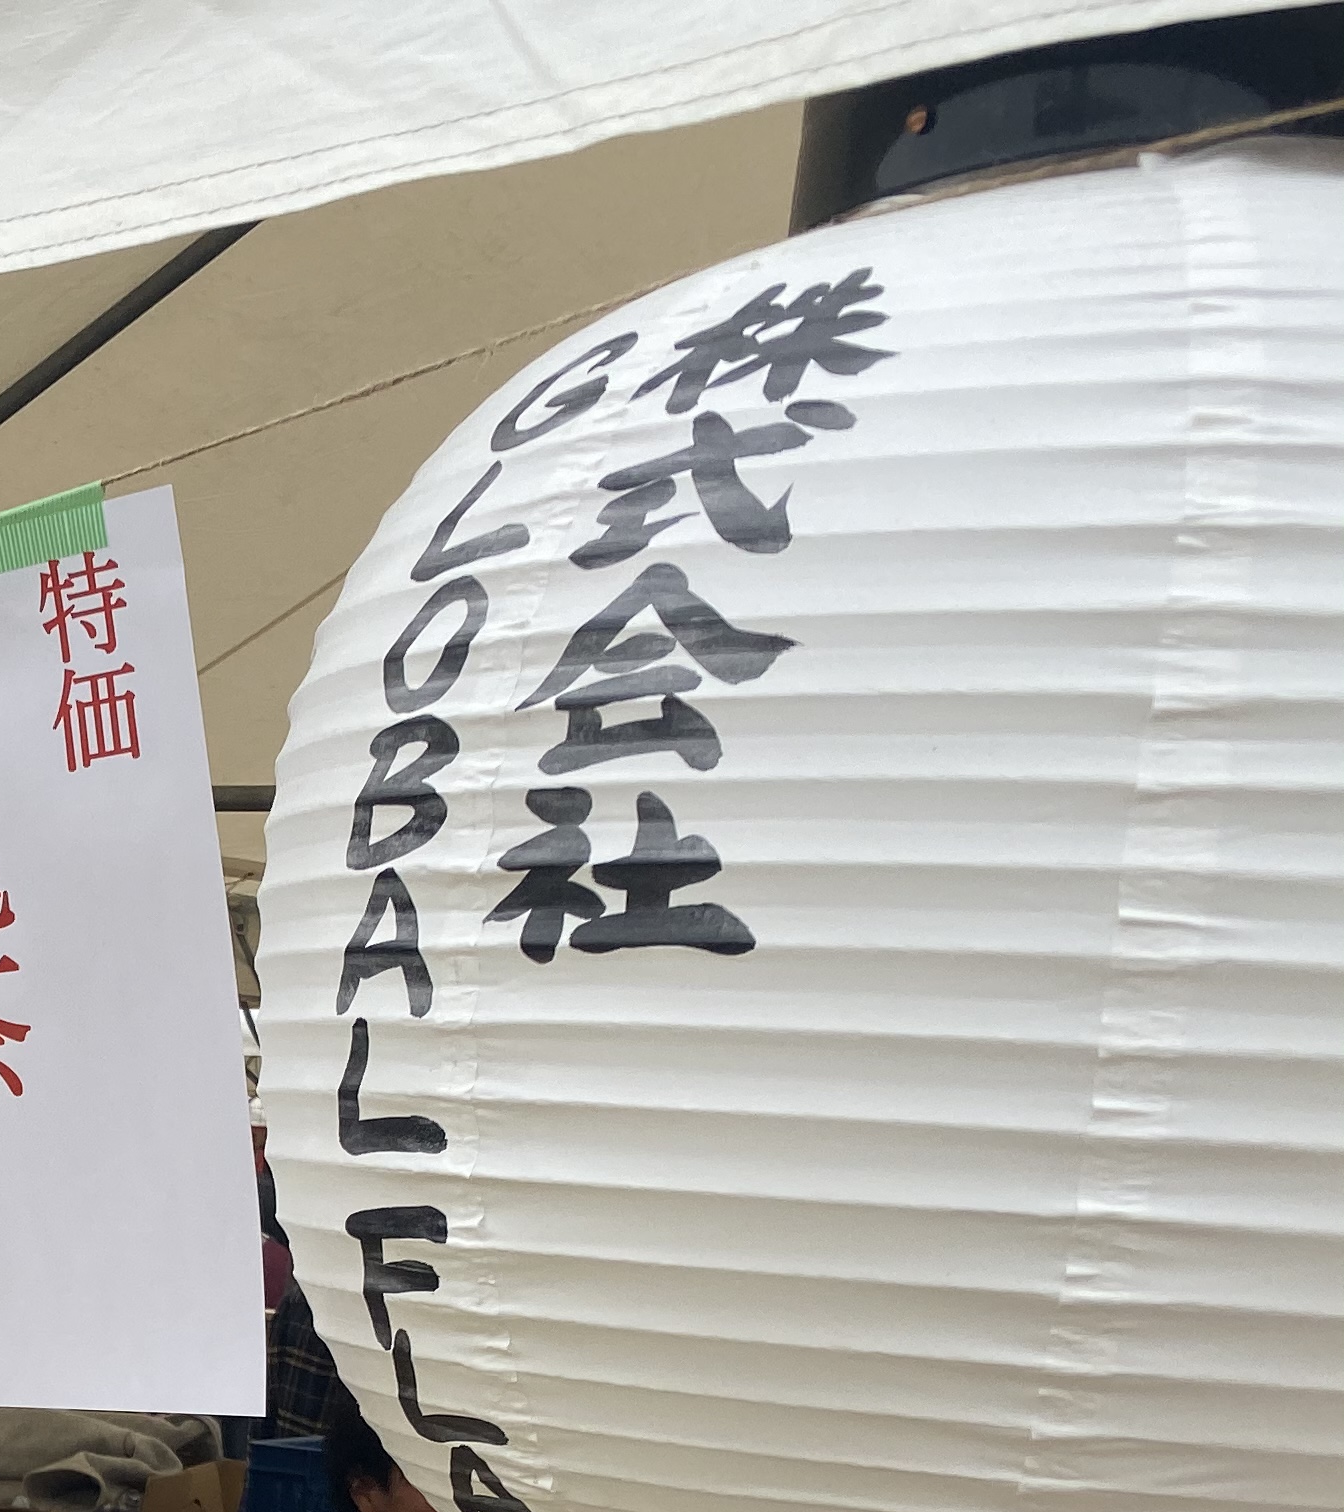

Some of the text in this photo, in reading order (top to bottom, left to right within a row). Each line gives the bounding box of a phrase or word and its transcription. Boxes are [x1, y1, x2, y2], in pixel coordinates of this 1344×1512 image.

[38, 551, 143, 774] 特価
[336, 332, 638, 1156] GLOBAL
[483, 267, 902, 963] 株式会社
